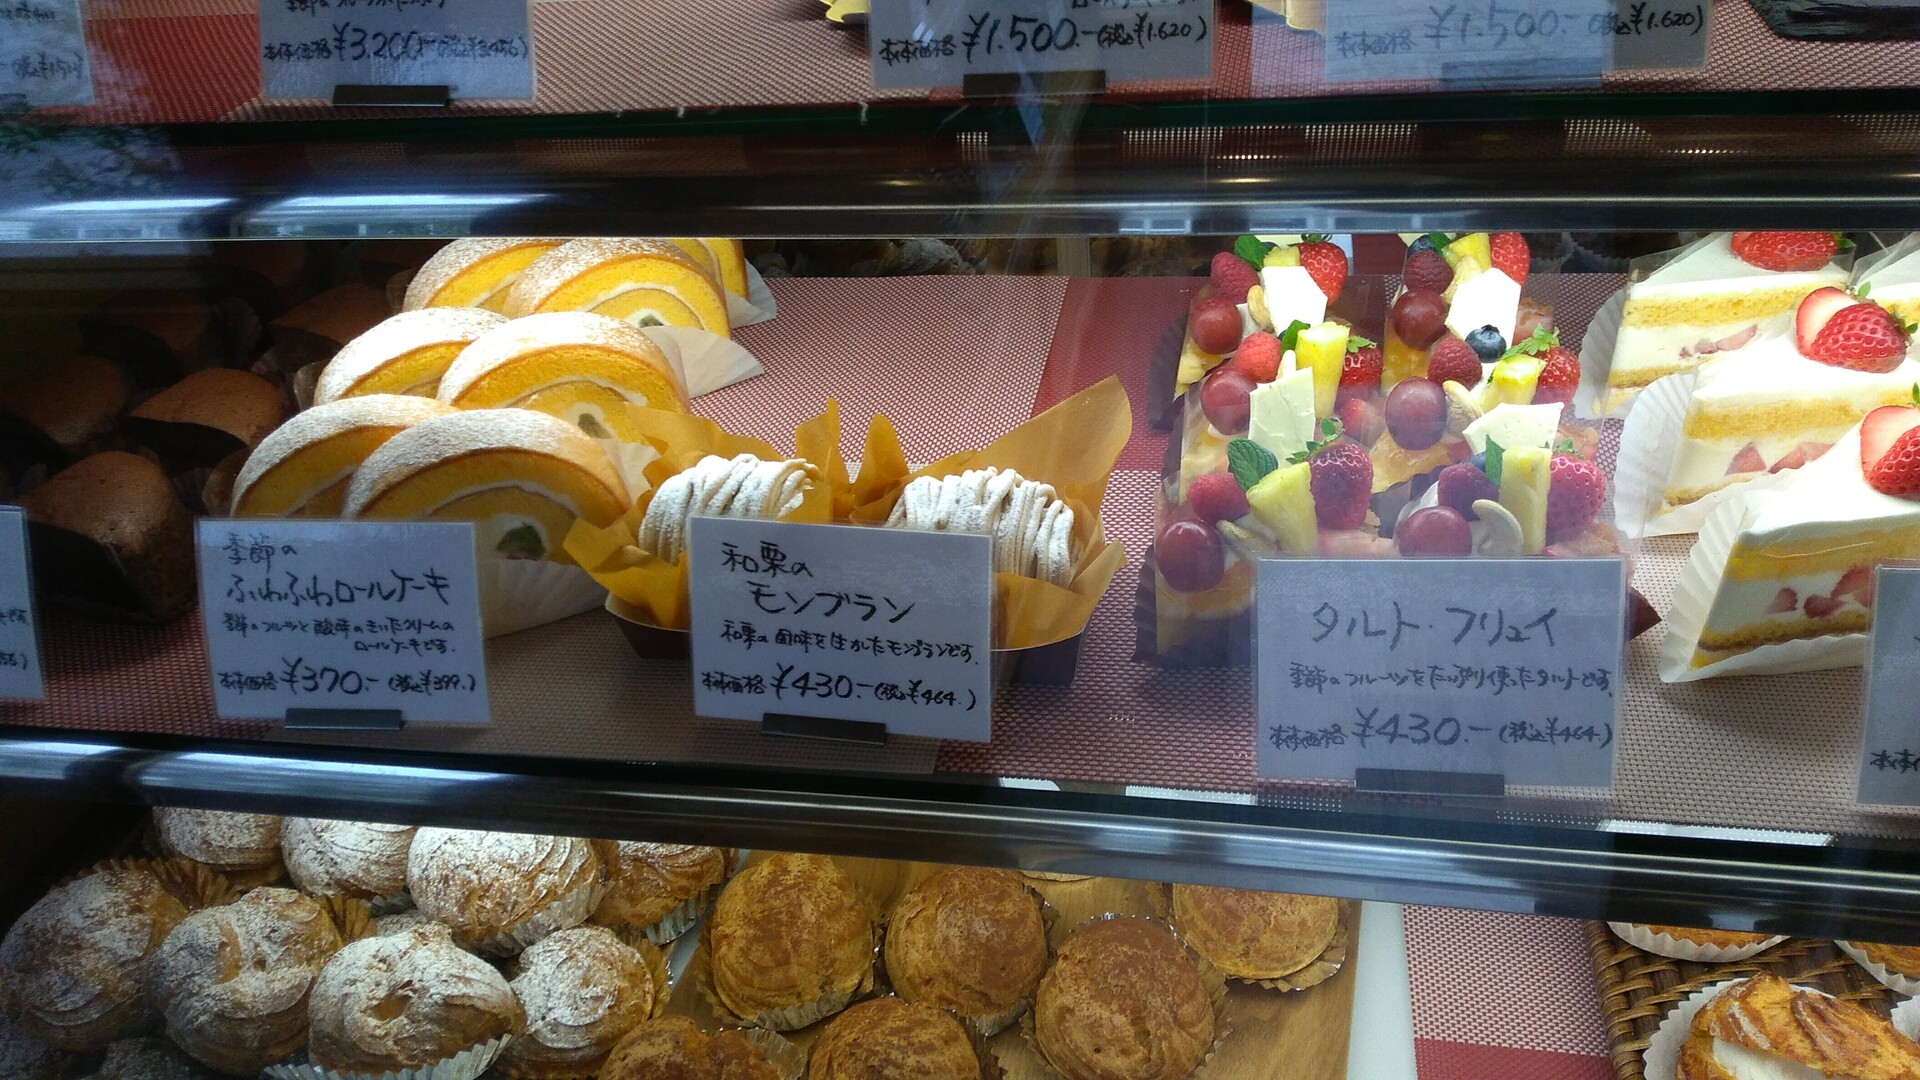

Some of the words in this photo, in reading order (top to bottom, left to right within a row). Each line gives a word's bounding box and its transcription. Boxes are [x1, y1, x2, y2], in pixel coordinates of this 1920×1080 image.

[222, 532, 298, 574] 季節の
[721, 540, 814, 578] 和栗の
[226, 567, 451, 607] ふわふわロールケーキ
[746, 580, 916, 624] モンブラン
[217, 671, 279, 697] 本体価格
[700, 670, 767, 699] 本体価格
[1268, 723, 1347, 751] 本体価格
